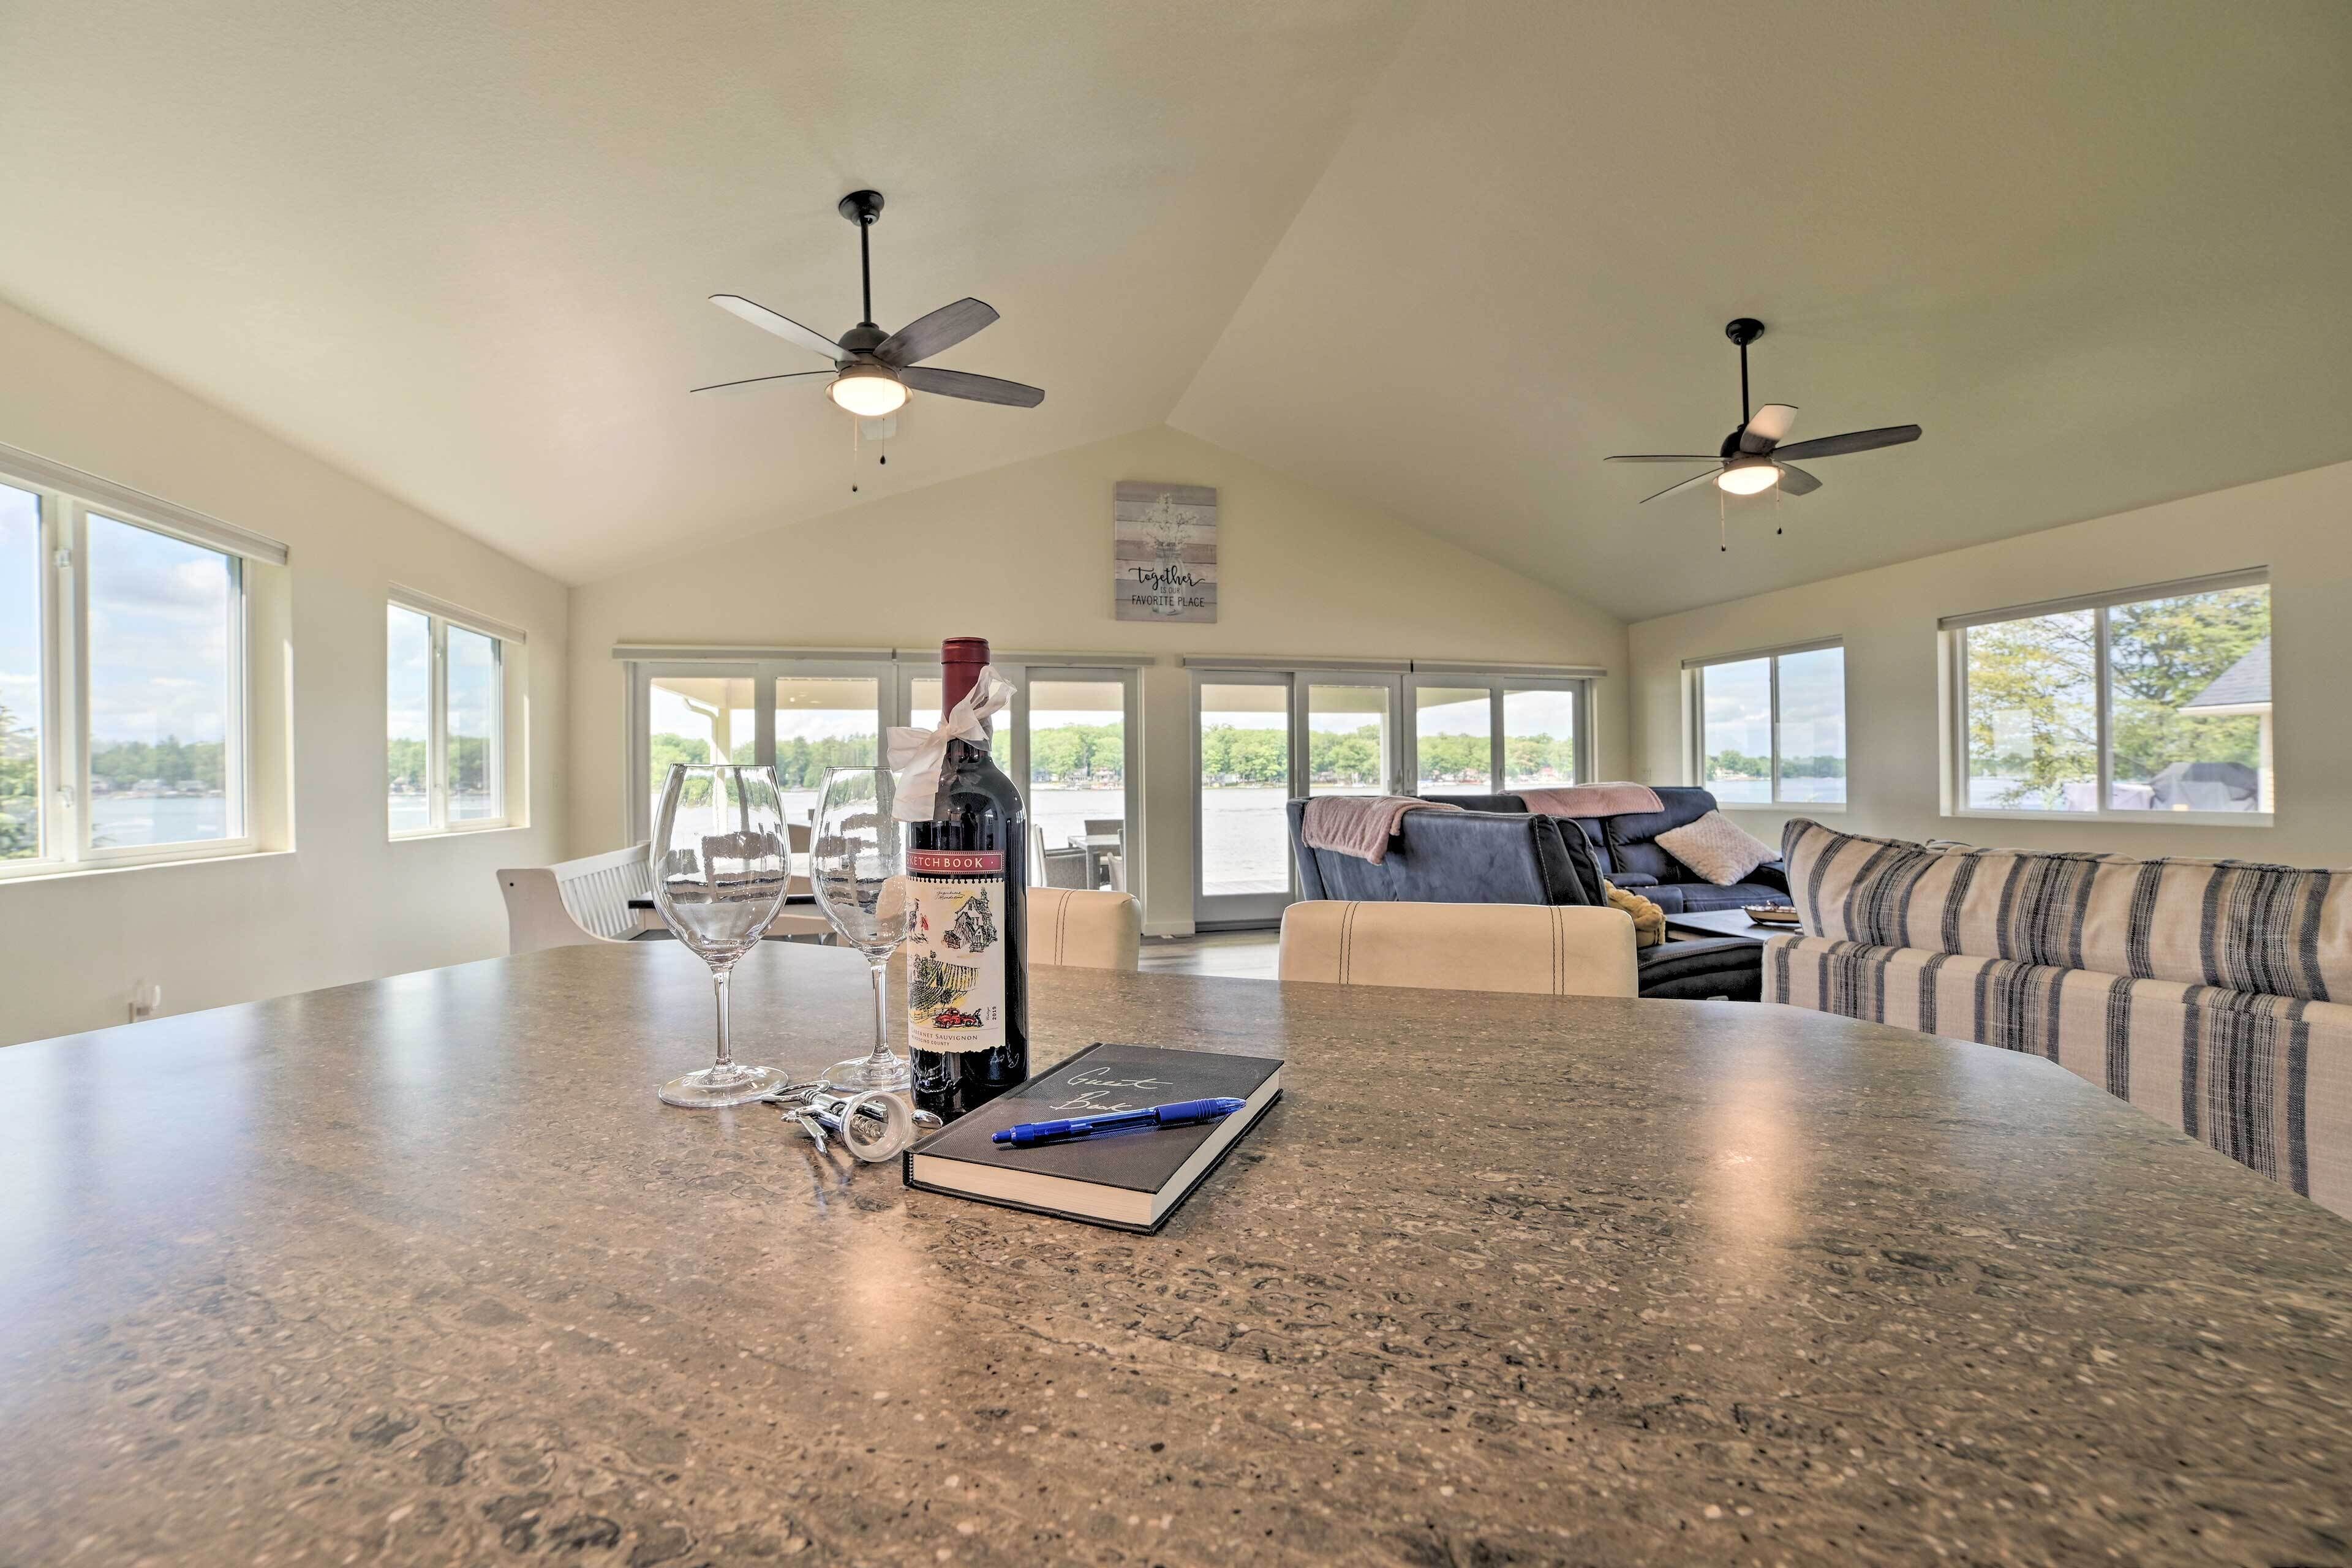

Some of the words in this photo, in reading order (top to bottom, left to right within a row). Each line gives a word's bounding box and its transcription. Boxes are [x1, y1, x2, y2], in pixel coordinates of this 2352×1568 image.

[1128, 565, 1205, 590] together
[1132, 595, 1174, 606] FAVORITE
[1178, 597, 1205, 607] PLACE
[1068, 1067, 1173, 1089] Guest
[1049, 1091, 1132, 1112] Book
